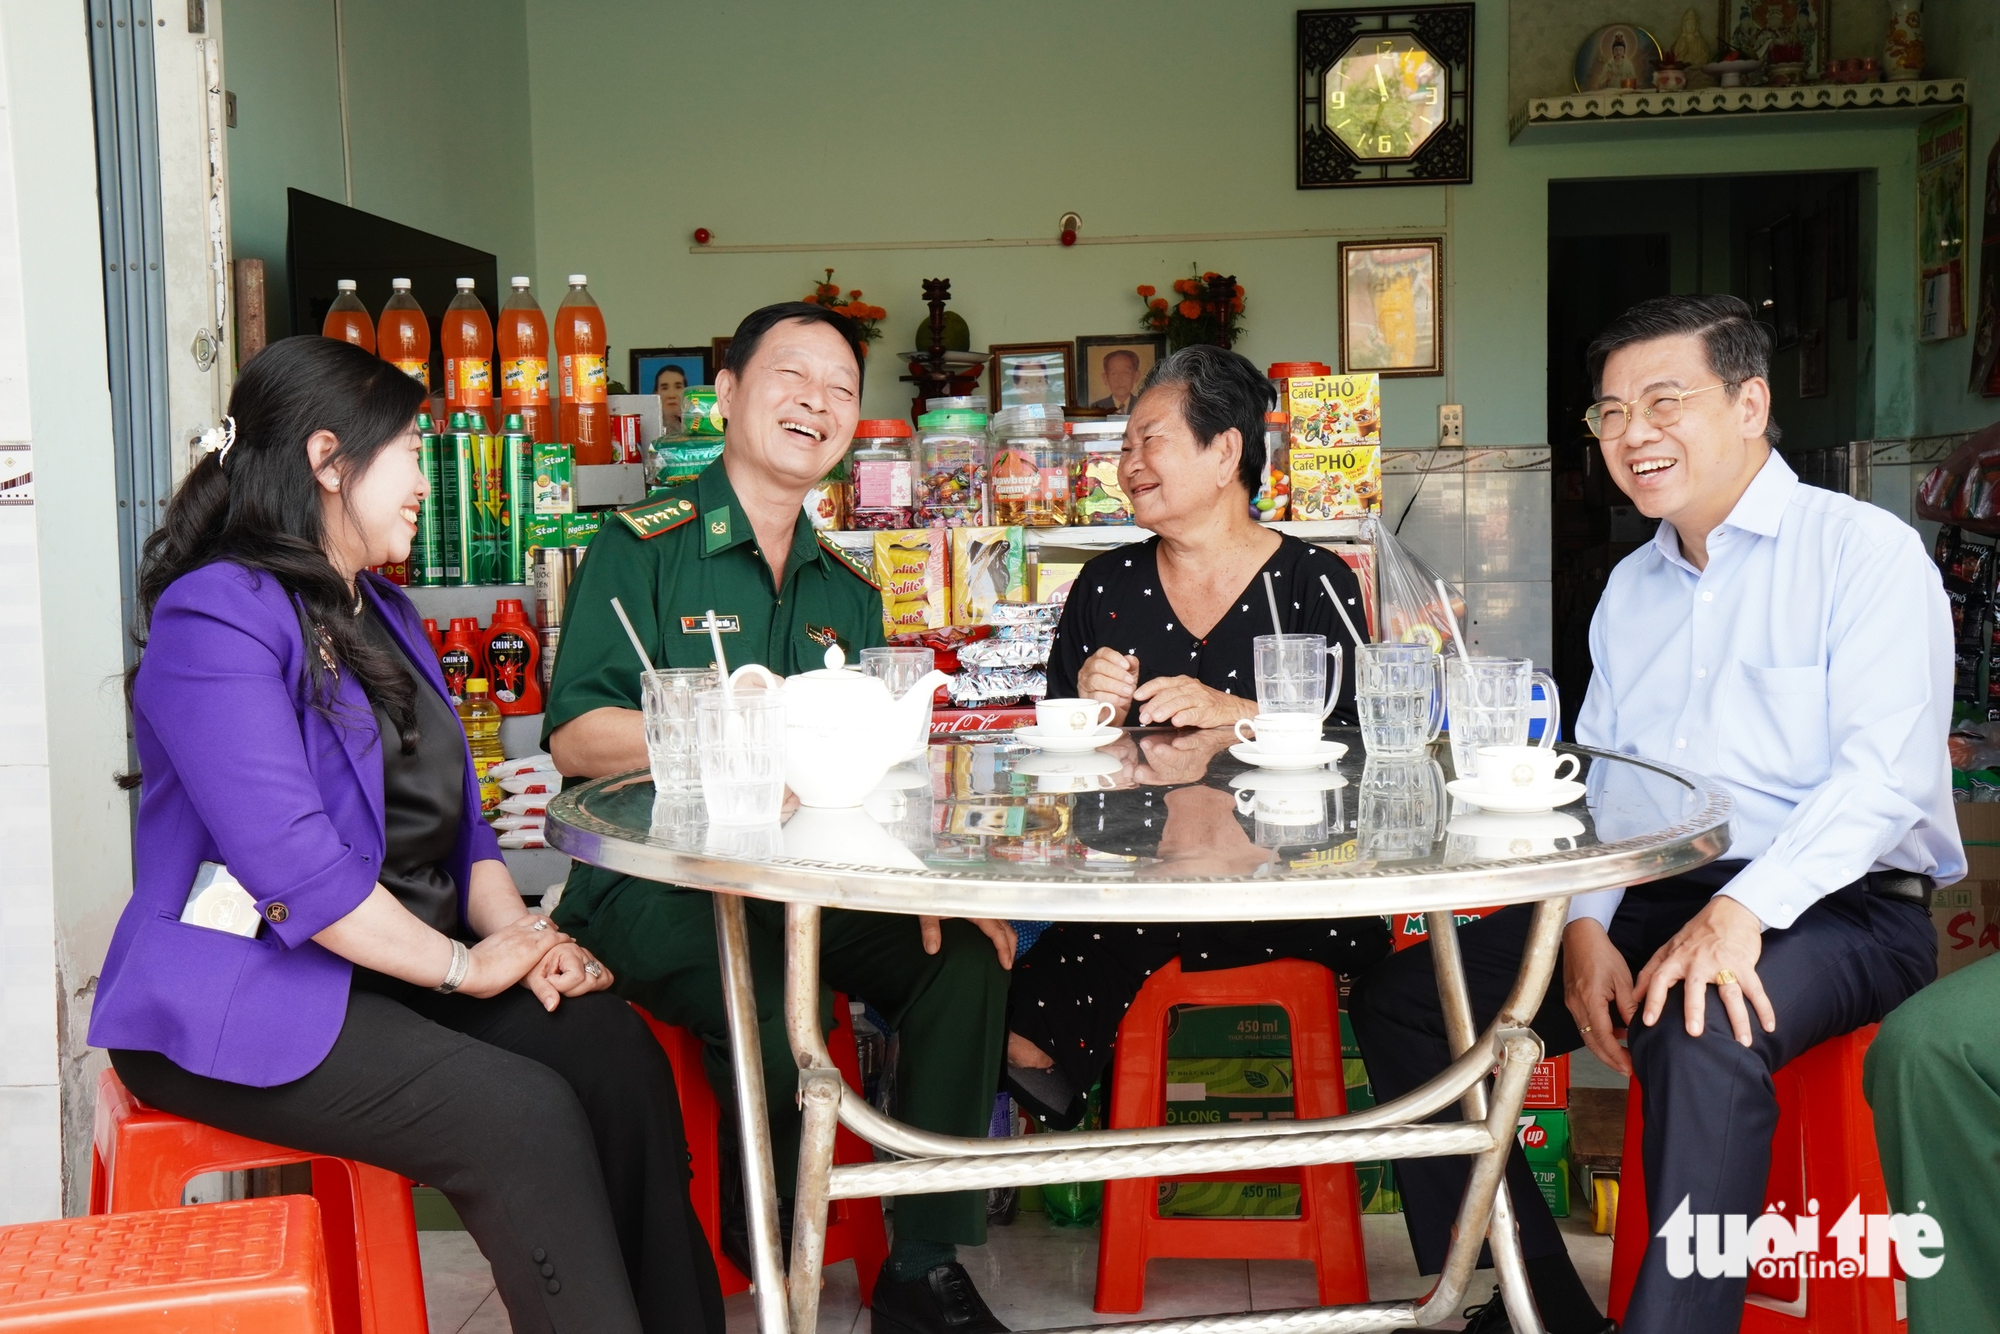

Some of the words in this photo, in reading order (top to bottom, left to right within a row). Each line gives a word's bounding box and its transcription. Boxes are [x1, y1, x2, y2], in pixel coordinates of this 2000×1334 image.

[1376, 41, 1394, 60] 12
[1331, 91, 1345, 109] 9
[1425, 87, 1438, 105] 3
[1377, 135, 1391, 153] 6
[1292, 388, 1314, 399] Café
[1315, 376, 1355, 398] PHỐ
[544, 456, 566, 466] Star
[1292, 460, 1315, 471] Café
[1316, 448, 1356, 470] PHỐ
[996, 485, 1032, 495] Gummy
[535, 526, 558, 536] Star
[567, 524, 584, 535] Ngôi
[492, 641, 523, 649] CHIN-SU
[1237, 1021, 1259, 1033] 450
[1263, 1020, 1278, 1032] ml
[1180, 1110, 1220, 1123] LONG
[1540, 1172, 1556, 1182] 7UP
[1241, 1185, 1263, 1198] 450
[1266, 1184, 1281, 1197] ml
